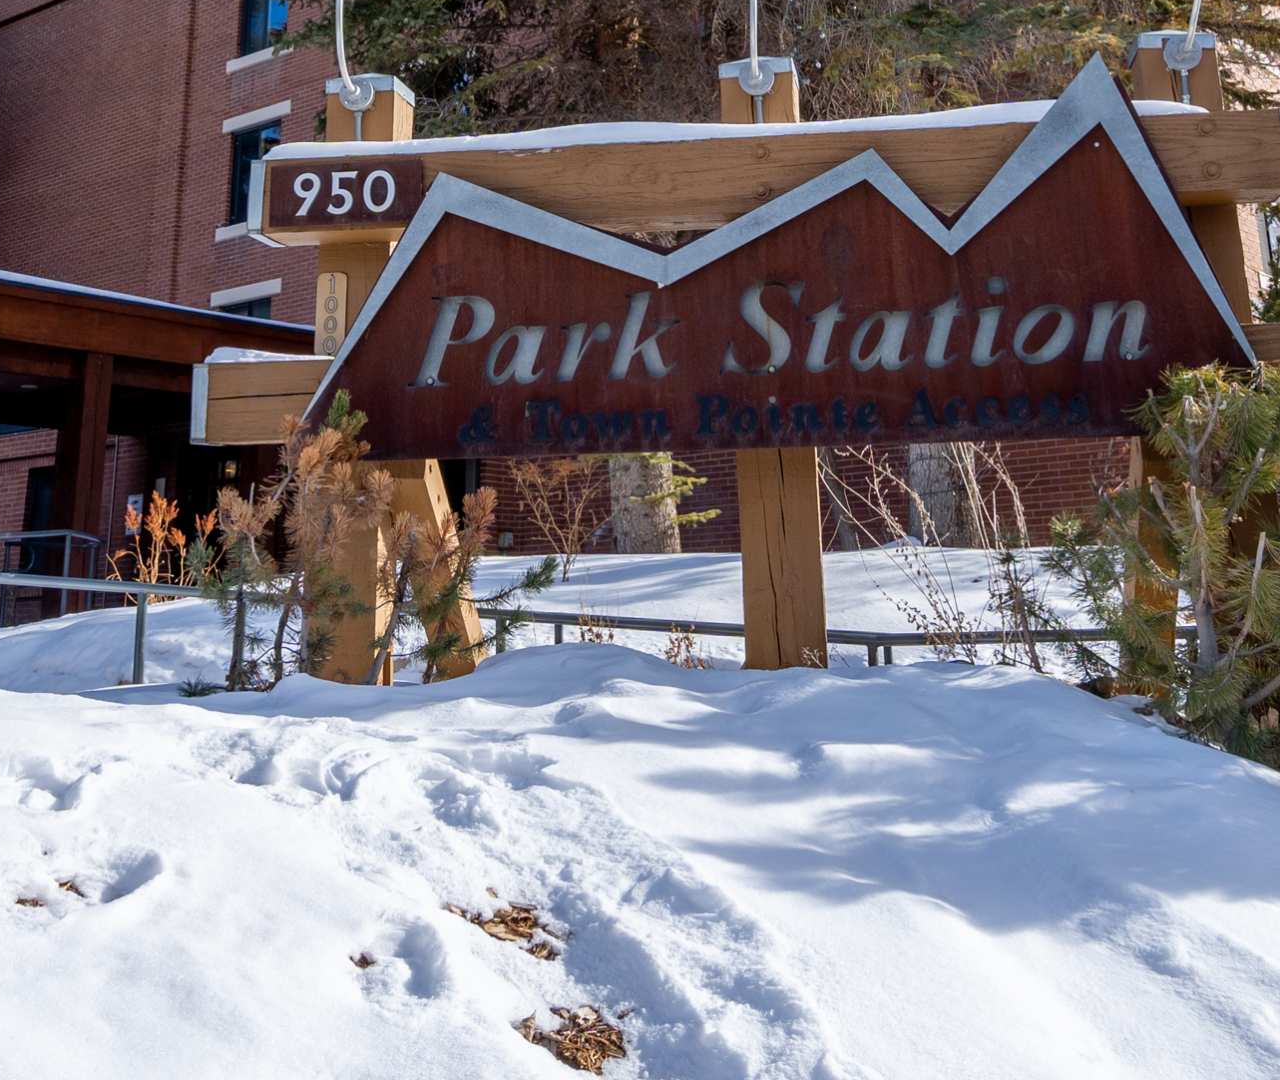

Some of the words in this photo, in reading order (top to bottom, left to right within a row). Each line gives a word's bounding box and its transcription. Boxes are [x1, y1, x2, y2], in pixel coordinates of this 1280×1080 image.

[293, 169, 396, 217] 950
[408, 290, 681, 388] Park
[721, 275, 1152, 375] Station
[457, 402, 497, 446] &
[525, 398, 669, 443] Town
[693, 391, 881, 436] Pointe
[904, 386, 1091, 430] Access
